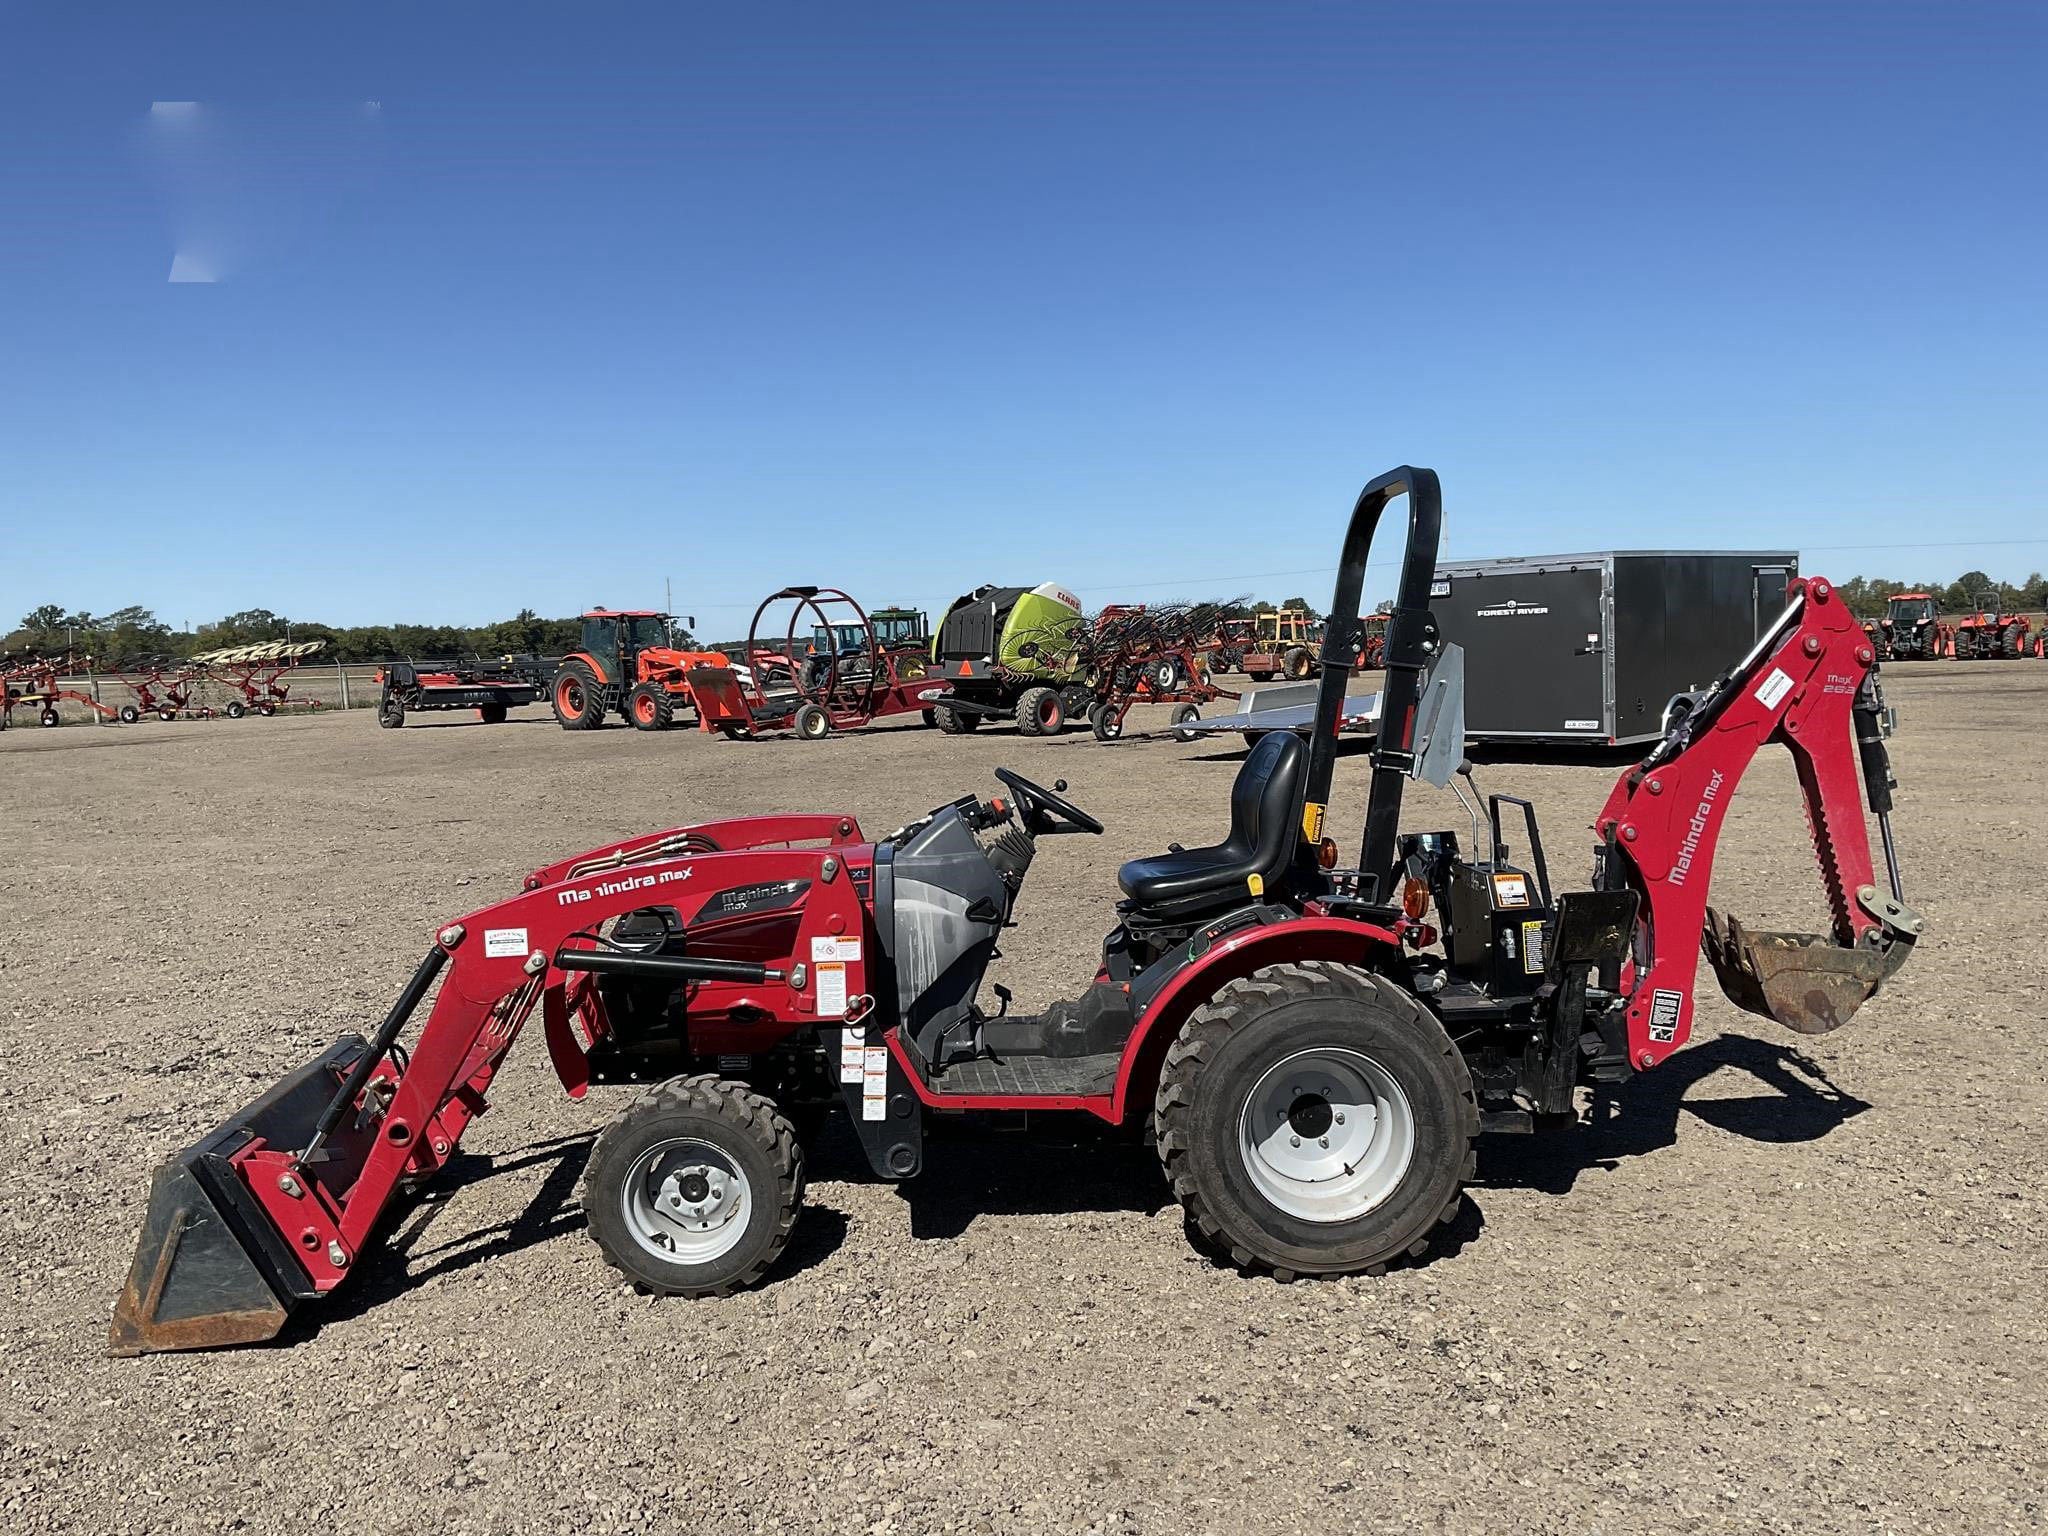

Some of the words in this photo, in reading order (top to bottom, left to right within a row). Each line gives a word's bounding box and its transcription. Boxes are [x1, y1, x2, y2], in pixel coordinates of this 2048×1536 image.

[1056, 591, 1080, 610] CLAAS
[1477, 609, 1516, 617] FOREST
[1517, 607, 1548, 615] RIVER
[1667, 802, 1712, 886] Mahindra
